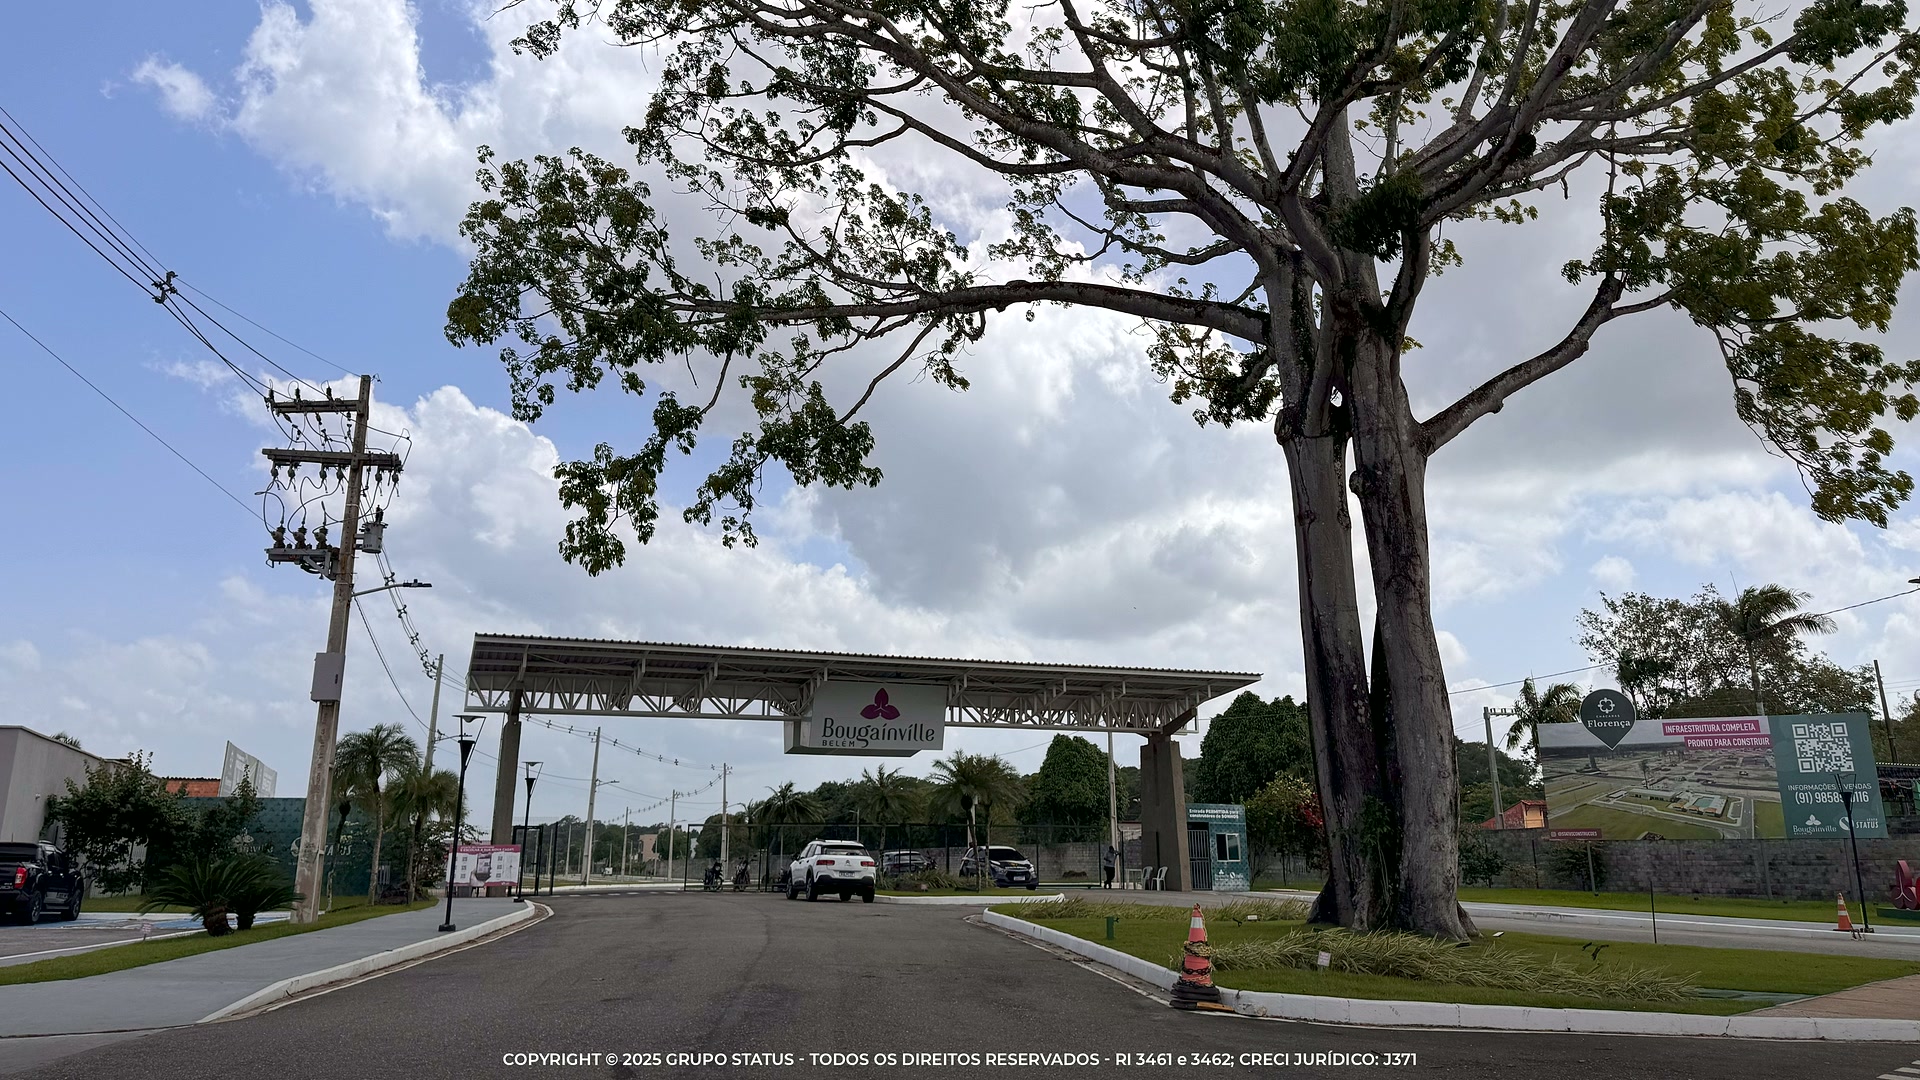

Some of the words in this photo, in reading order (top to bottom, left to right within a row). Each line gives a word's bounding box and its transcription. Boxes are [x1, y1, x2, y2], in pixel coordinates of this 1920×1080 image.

[1587, 719, 1631, 729] Florença
[1665, 723, 1720, 733] INFRAESTRUTURA
[1721, 722, 1756, 732] COMPLETA
[822, 738, 855, 747] BELÉM
[1687, 738, 1713, 747] PRONTO
[1714, 737, 1732, 747] PARA
[1732, 736, 1770, 746] CONSTRUIR
[1787, 783, 1837, 792] INFORMAÇÕES
[1843, 782, 1872, 790] VENDAS
[1795, 791, 1813, 805] (91)
[1793, 824, 1837, 836] Bougainville
[1856, 821, 1879, 829] STATUS
